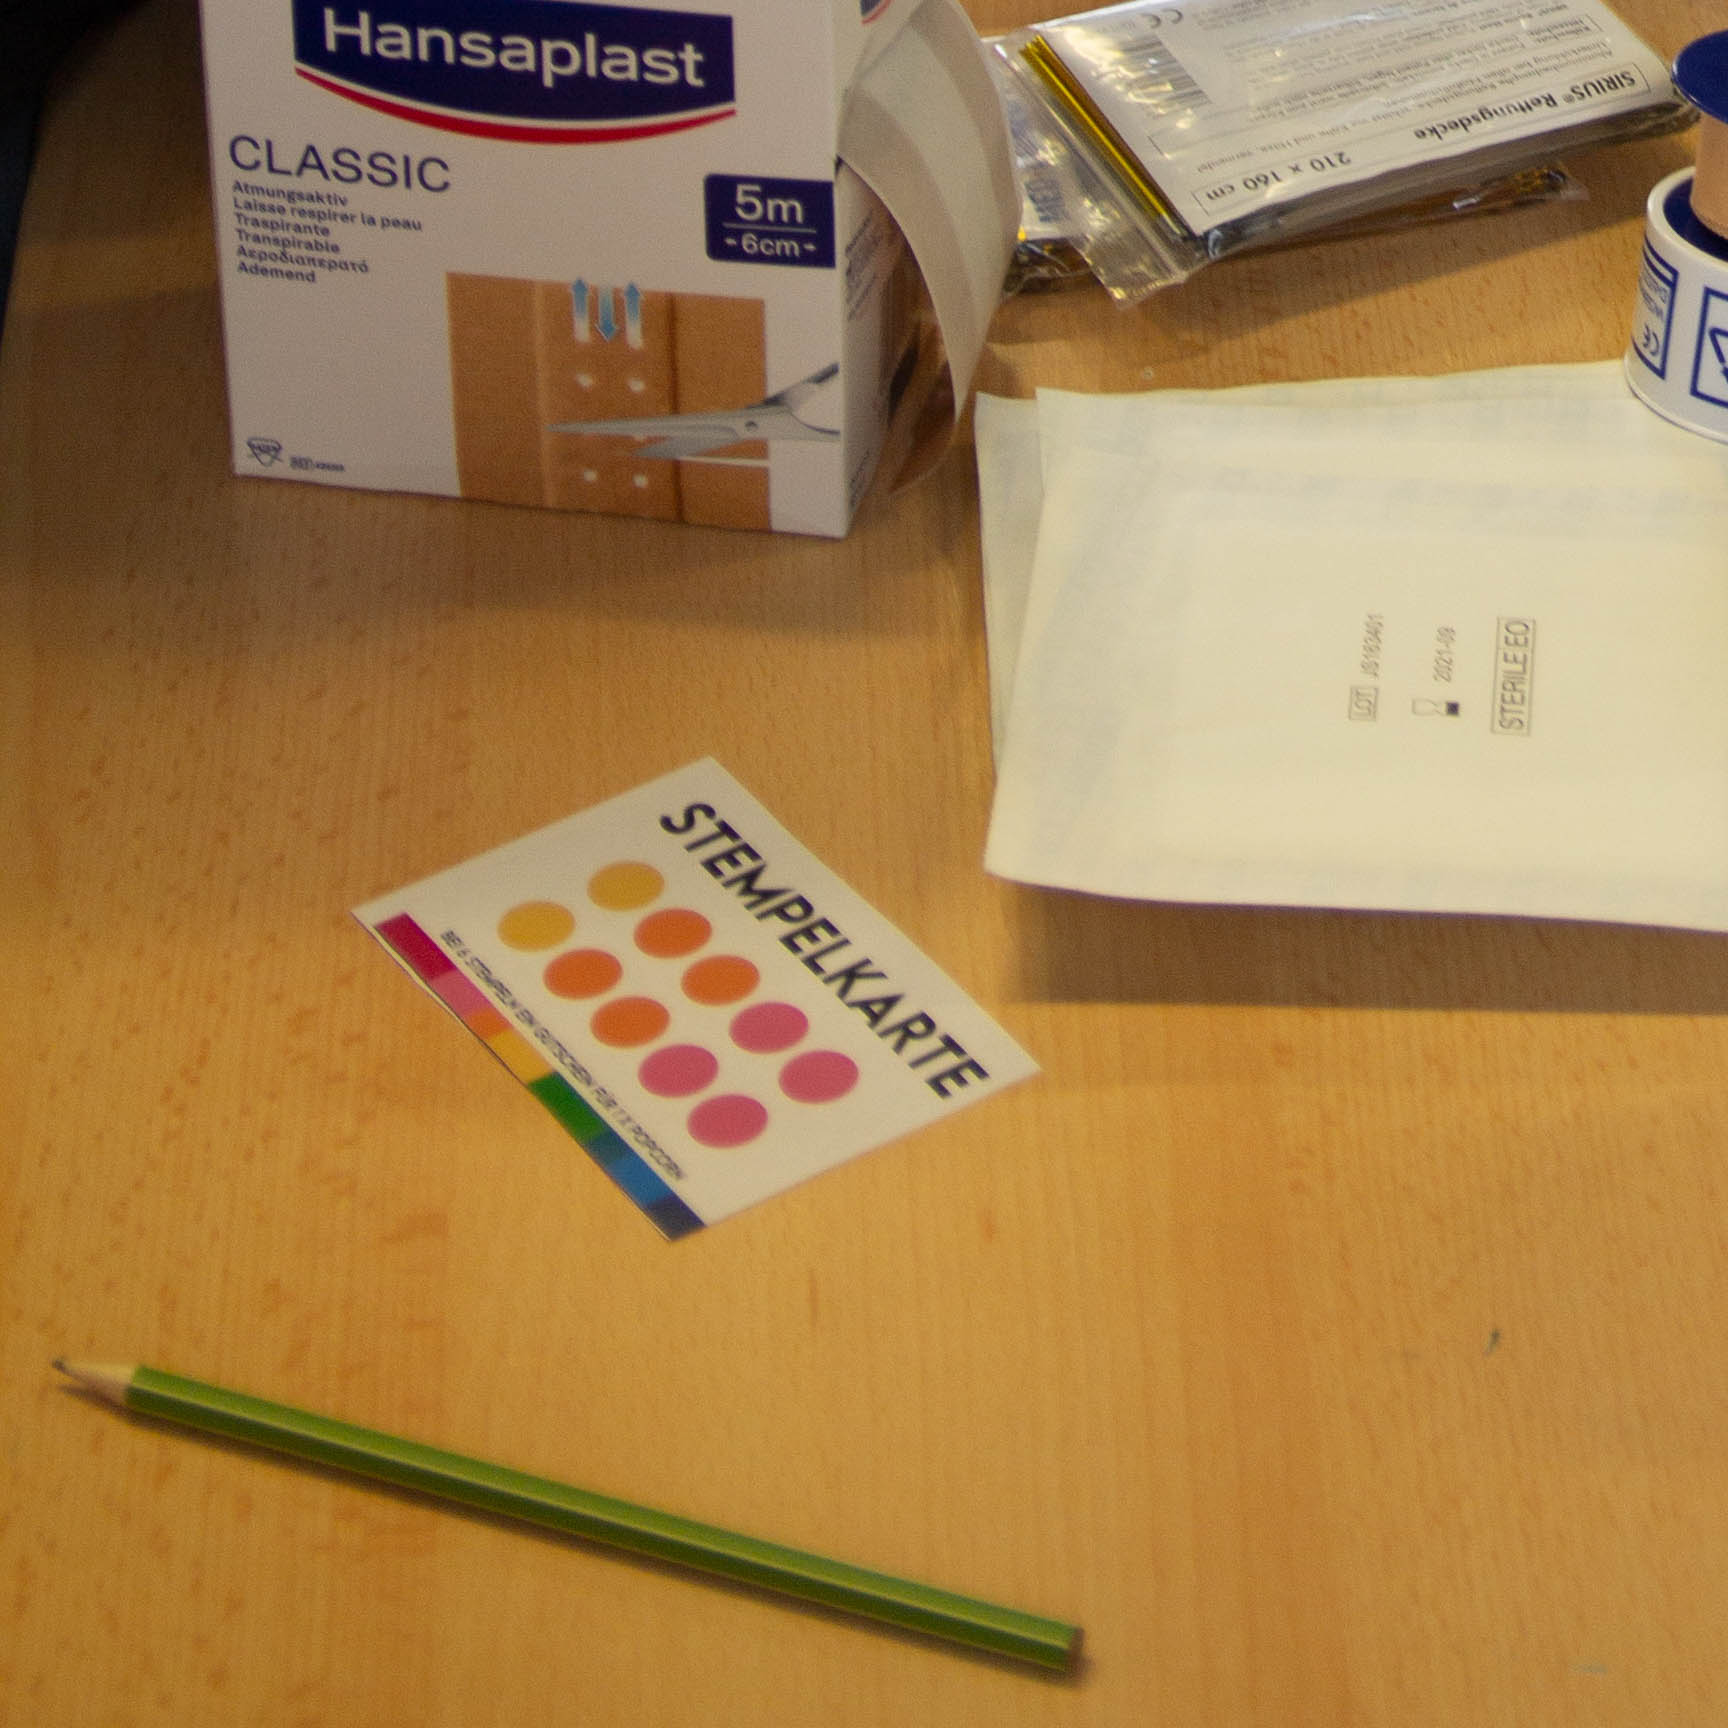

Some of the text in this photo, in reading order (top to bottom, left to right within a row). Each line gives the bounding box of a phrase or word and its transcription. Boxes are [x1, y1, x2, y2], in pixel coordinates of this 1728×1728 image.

[323, 6, 706, 88] Hansaplast
[1407, 88, 1562, 145] Rettungsdecke
[228, 135, 451, 193] CLASSIC
[1305, 149, 1354, 173] 210
[232, 180, 349, 207] Atmungsaktiv
[1201, 182, 1240, 201] cm
[1239, 169, 1285, 192] 160
[233, 196, 423, 232] Laisse respirer la peau
[734, 183, 805, 225] 5m
[234, 212, 330, 238] Traspirante
[236, 227, 341, 255] Transpirable
[238, 260, 317, 284] Ademend
[1498, 620, 1529, 731] STERILE EO
[1354, 690, 1373, 716] LOT
[660, 802, 989, 1099] STEMPELKARTE
